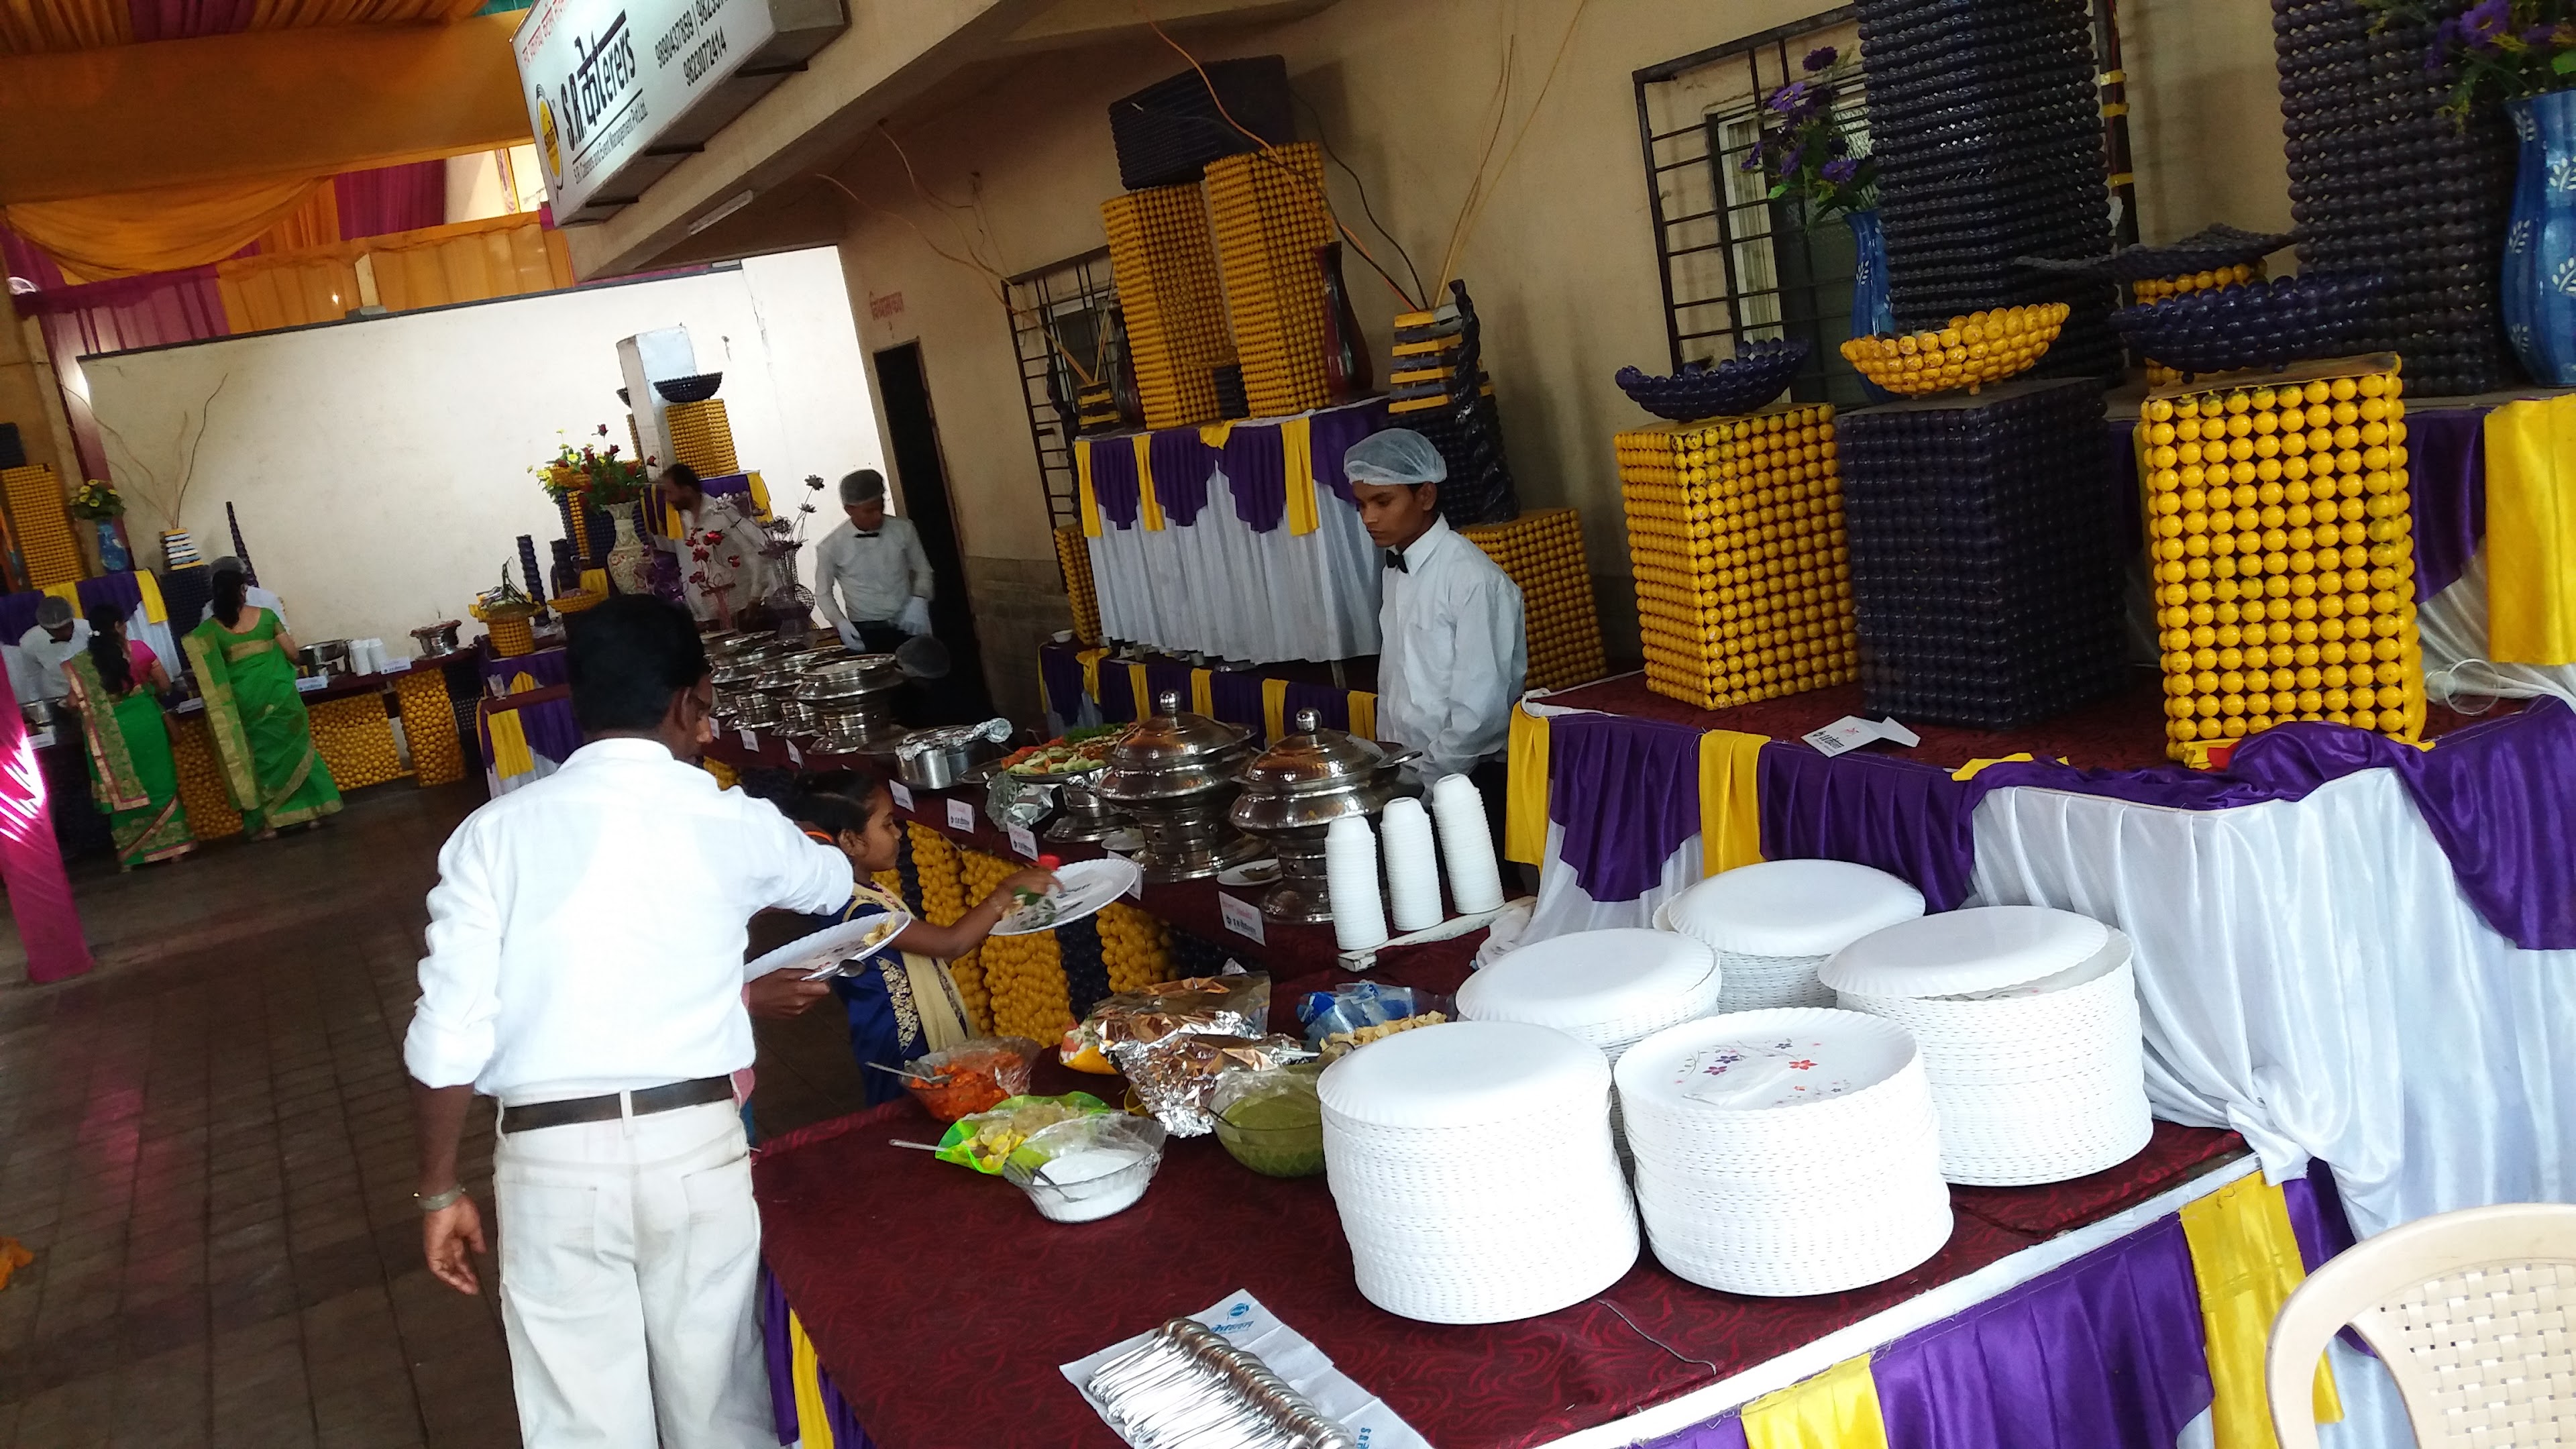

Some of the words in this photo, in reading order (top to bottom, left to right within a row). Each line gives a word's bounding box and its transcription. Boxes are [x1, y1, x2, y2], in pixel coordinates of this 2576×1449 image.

[655, 9, 694, 69] 9890437859
[683, 25, 727, 87] 9823072414
[561, 72, 588, 151] S.R.
